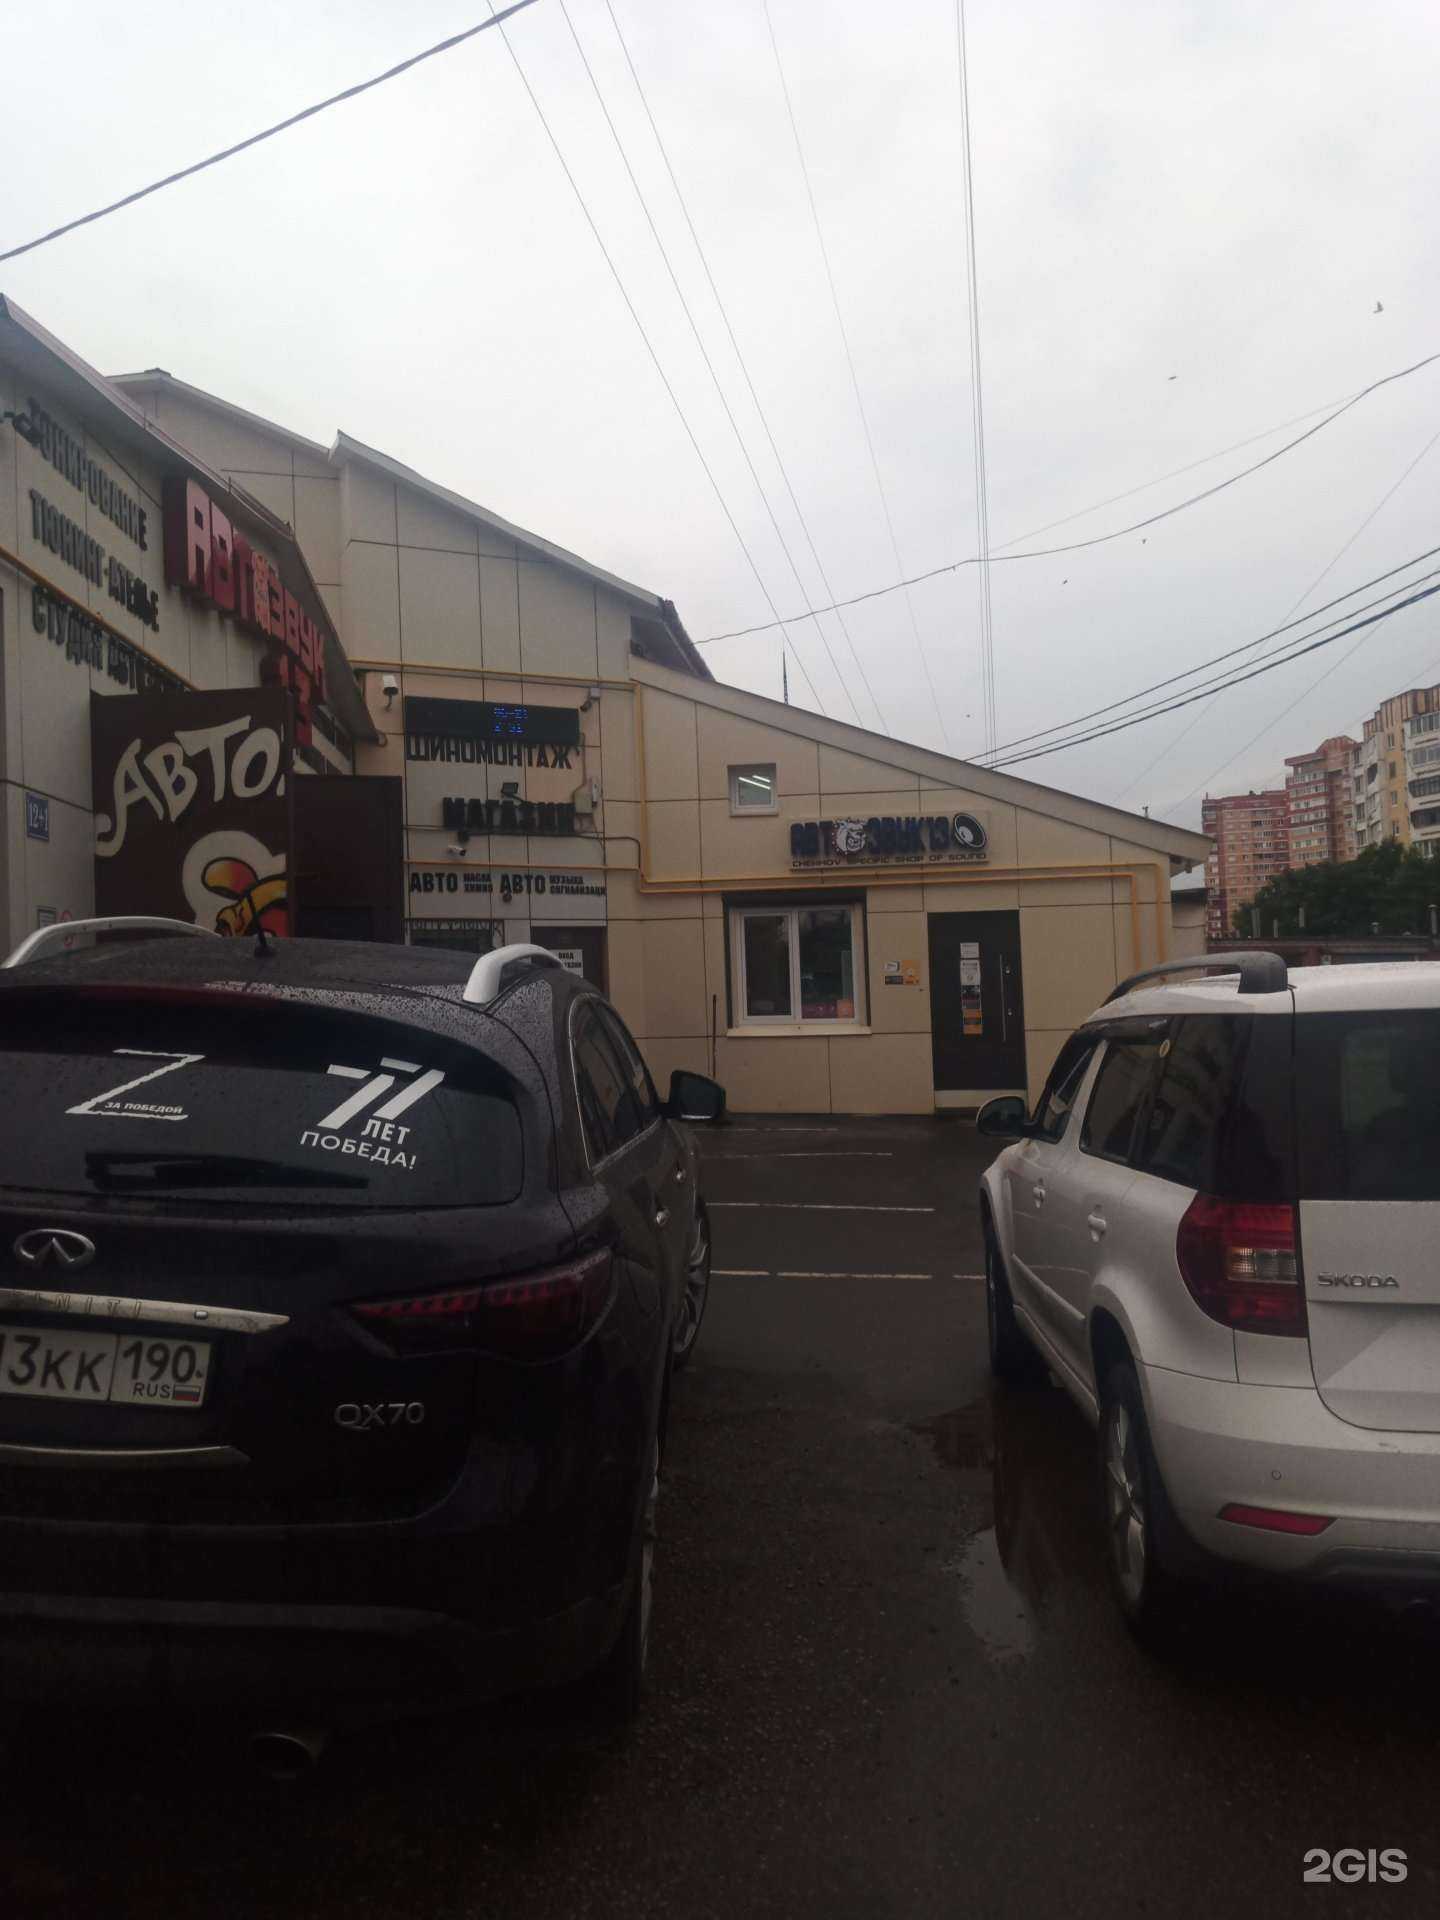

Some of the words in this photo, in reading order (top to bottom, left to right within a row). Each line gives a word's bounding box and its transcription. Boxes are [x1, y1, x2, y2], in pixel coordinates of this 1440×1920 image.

[406, 735, 574, 769] ШИНОМОНТАЖ
[442, 797, 575, 833] МАГАЗИН
[409, 872, 458, 893] АВТО
[499, 873, 546, 895] АВТО
[66, 1047, 205, 1121] Z
[317, 1057, 446, 1129] 77
[104, 1101, 123, 1110] ЗА
[124, 1102, 184, 1115] ПОБЕДОЙ
[361, 1118, 411, 1145] ЛЕТ
[300, 1130, 417, 1170] ПОБЕДА!
[123, 1340, 197, 1384] 190
[133, 1382, 170, 1399] RUS
[333, 1401, 426, 1431] QX70
